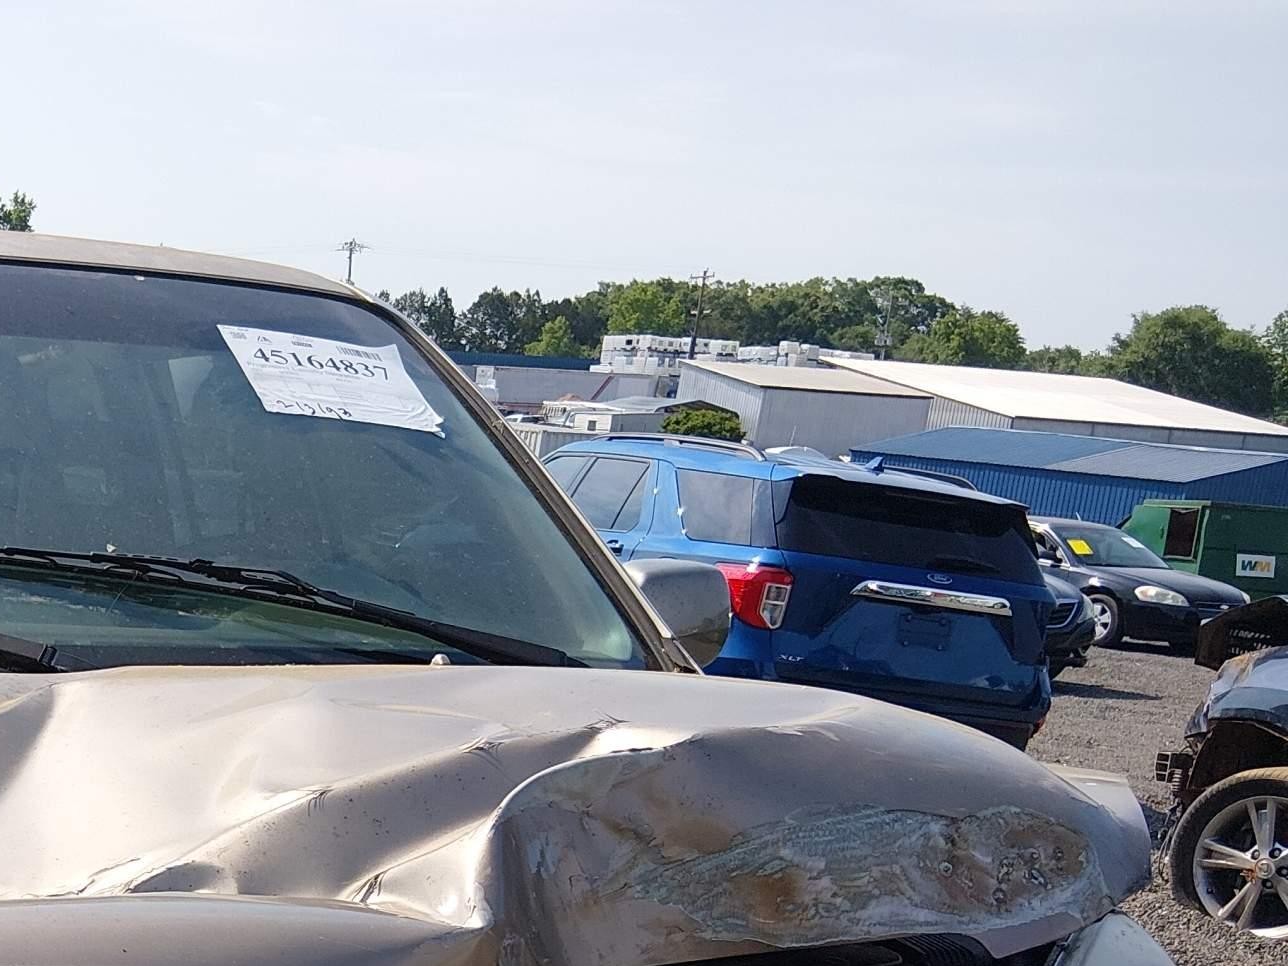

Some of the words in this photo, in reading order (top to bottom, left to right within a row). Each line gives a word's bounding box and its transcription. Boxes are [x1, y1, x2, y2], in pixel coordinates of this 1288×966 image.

[253, 347, 389, 381] 45164837
[1241, 559, 1272, 573] WM
[778, 654, 806, 662] XLT
